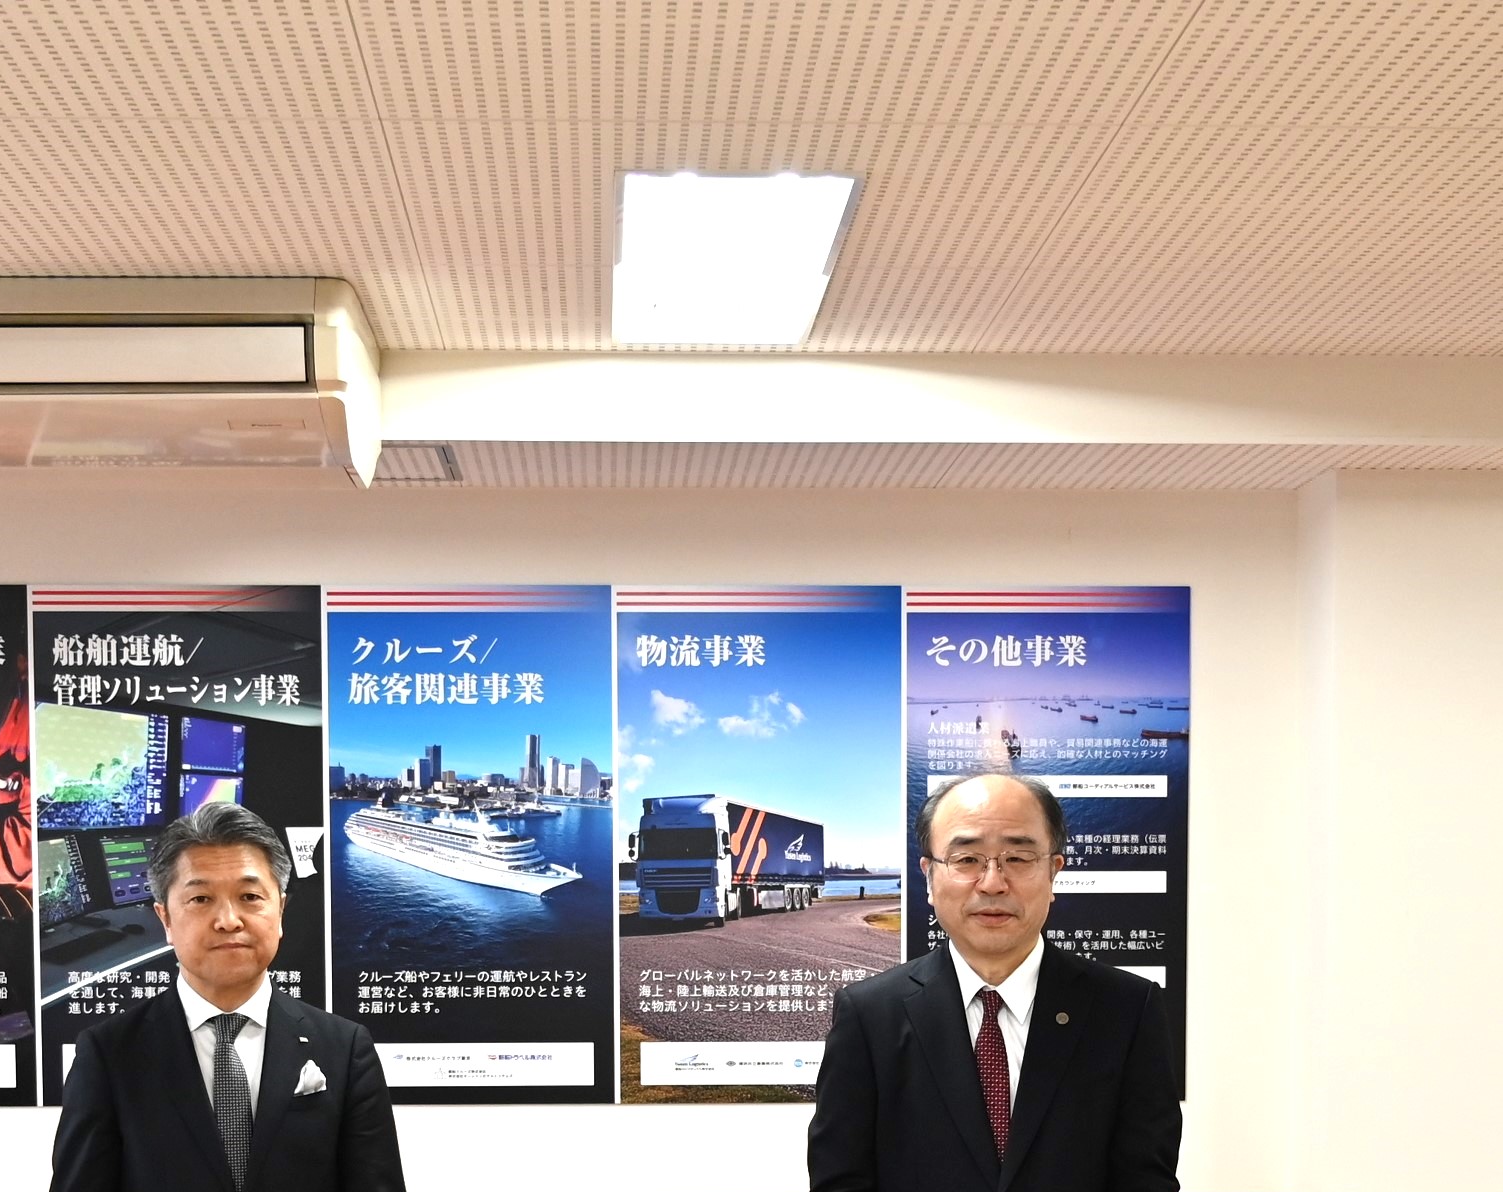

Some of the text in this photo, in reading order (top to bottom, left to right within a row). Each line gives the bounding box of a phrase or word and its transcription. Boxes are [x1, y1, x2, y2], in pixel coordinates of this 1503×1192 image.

[636, 634, 766, 667] 物流事業
[926, 635, 1087, 667] その他事業
[52, 674, 301, 706] 管理ソリューション事業
[348, 672, 545, 705] 旅客関連事業
[1062, 845, 1167, 855] 務、月次・期末決算資料
[358, 970, 587, 983] クルーズ船やフェリーの運航やレストラン
[358, 986, 587, 999] 運営など、お客様に非日常のひとときを
[358, 1001, 441, 1014] お届けします。
